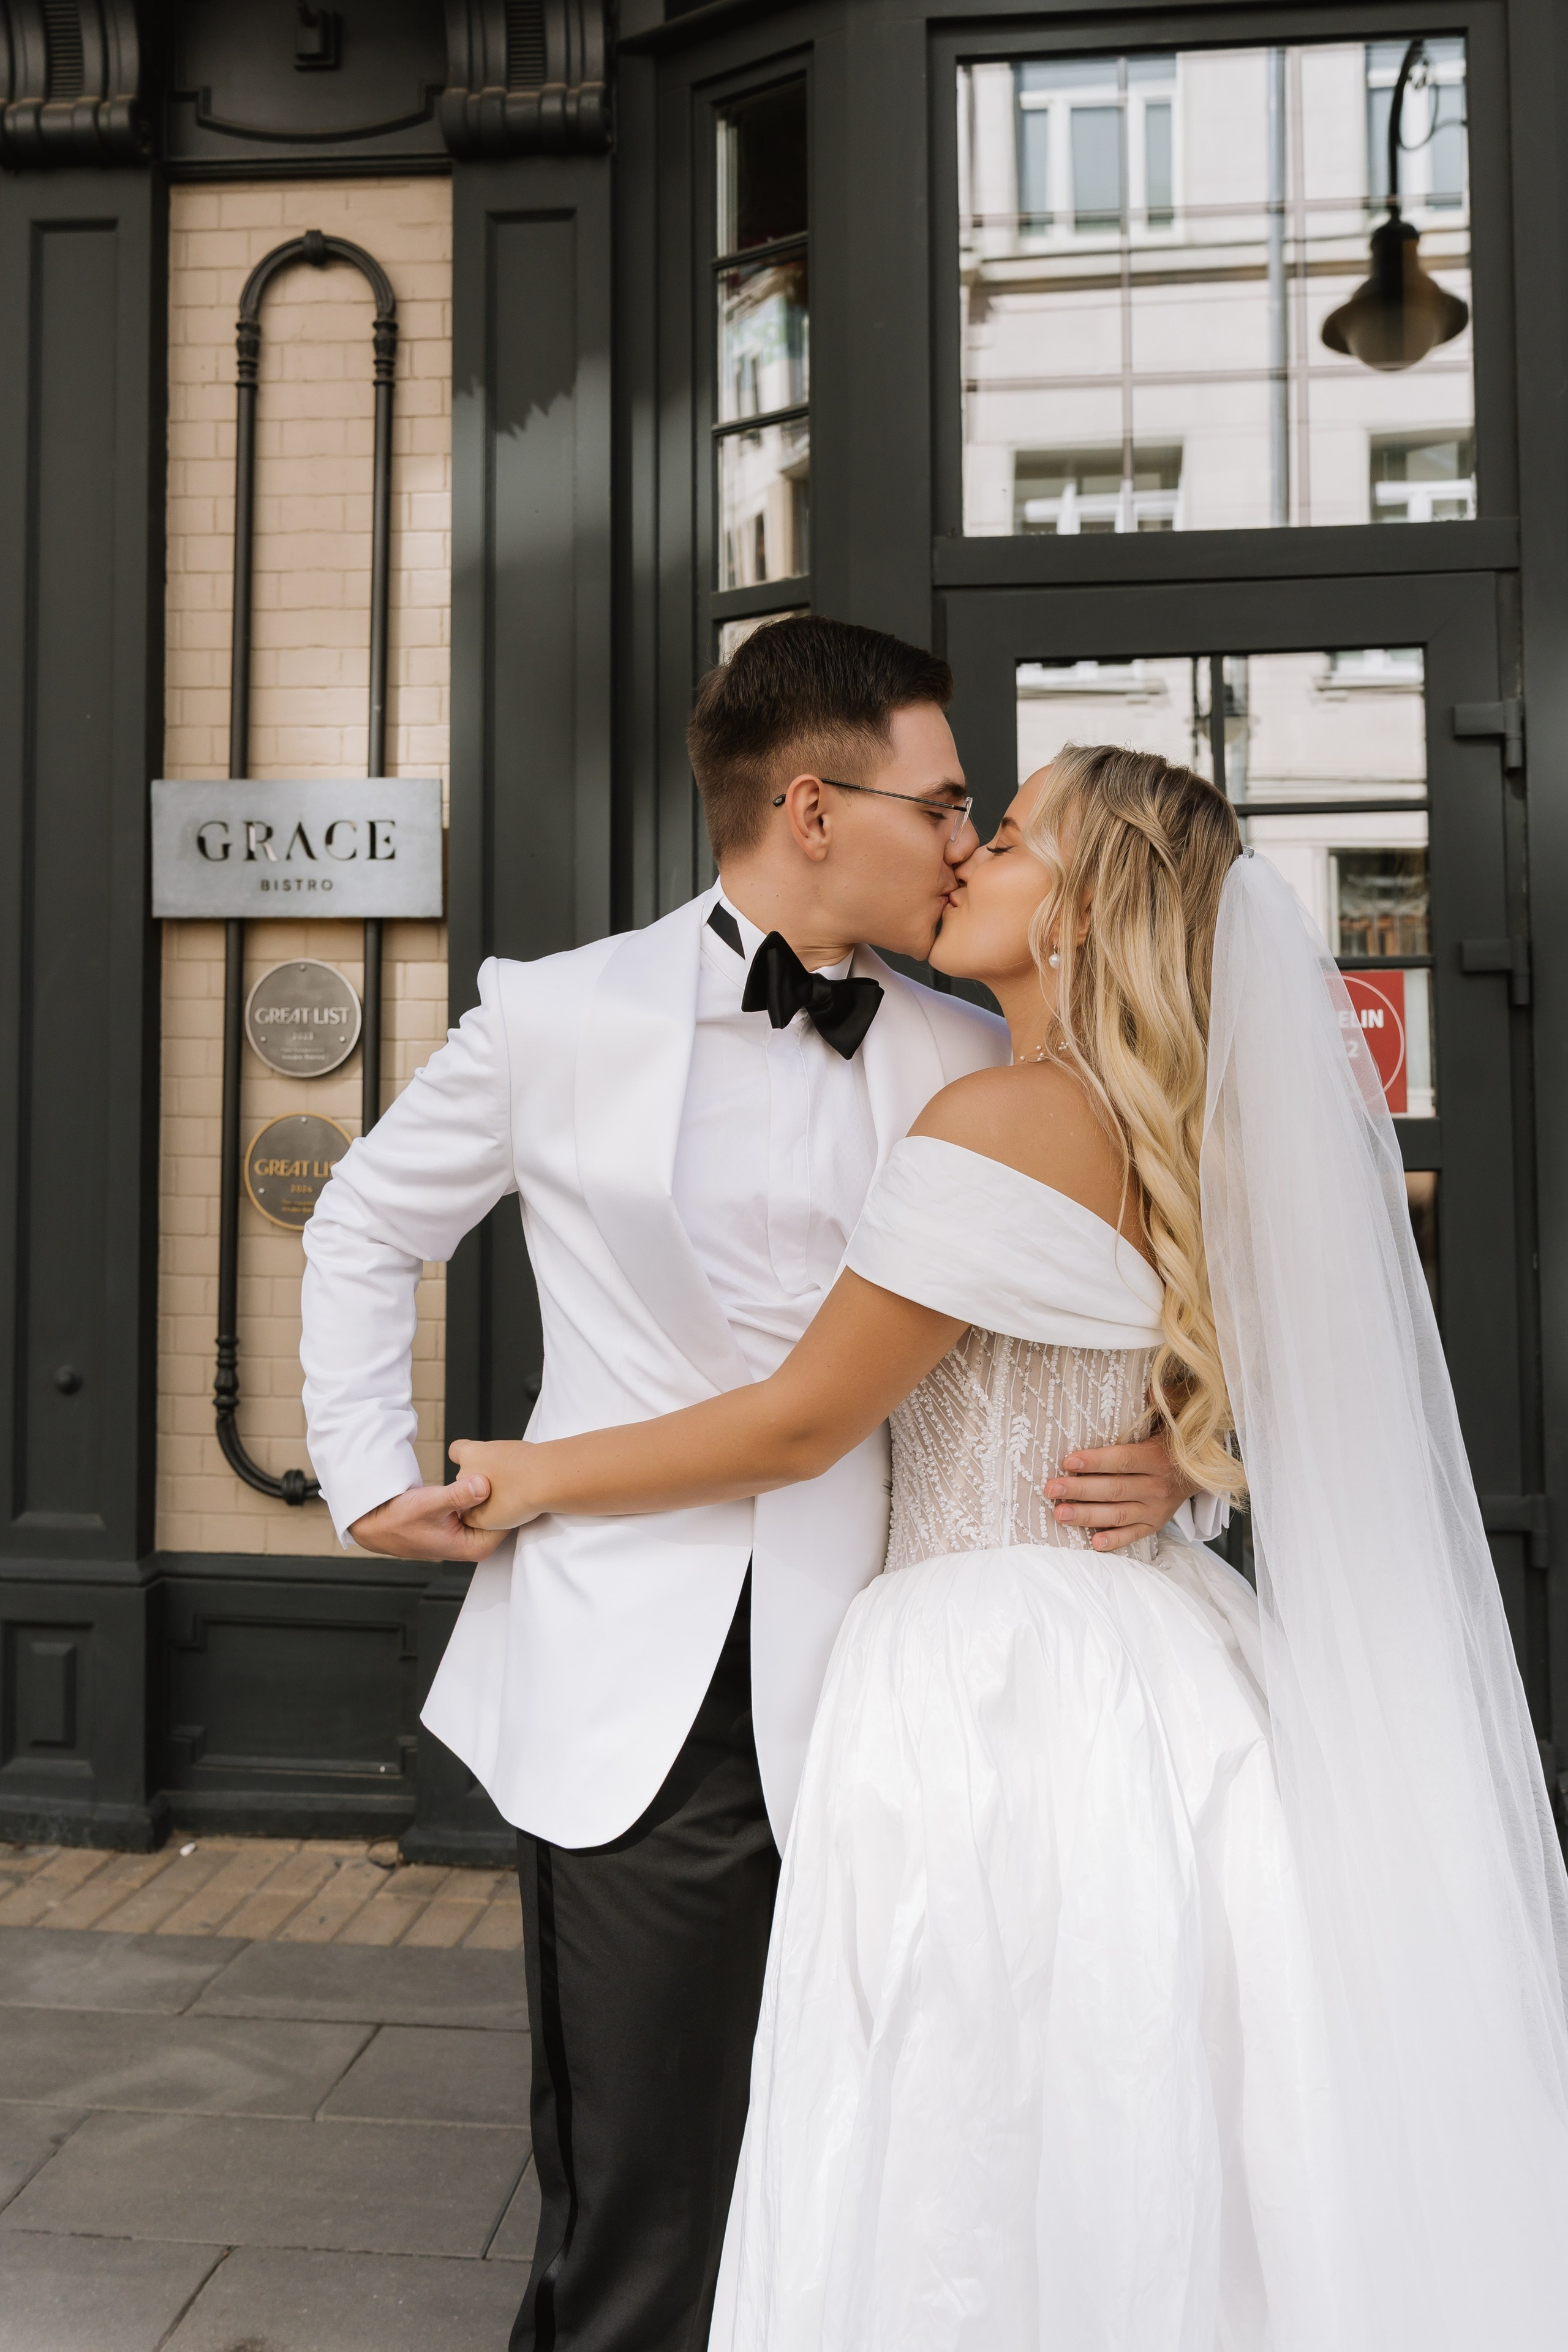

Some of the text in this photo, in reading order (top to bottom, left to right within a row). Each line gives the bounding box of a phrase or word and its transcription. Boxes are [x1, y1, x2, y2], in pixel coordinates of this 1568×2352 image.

[197, 820, 396, 862] GRACE
[260, 878, 334, 891] BISTRO
[254, 1006, 349, 1025] GREAT LIST
[1338, 1009, 1384, 1028] ELIN
[1346, 1040, 1360, 1058] 2
[254, 1158, 309, 1177] GREAT
